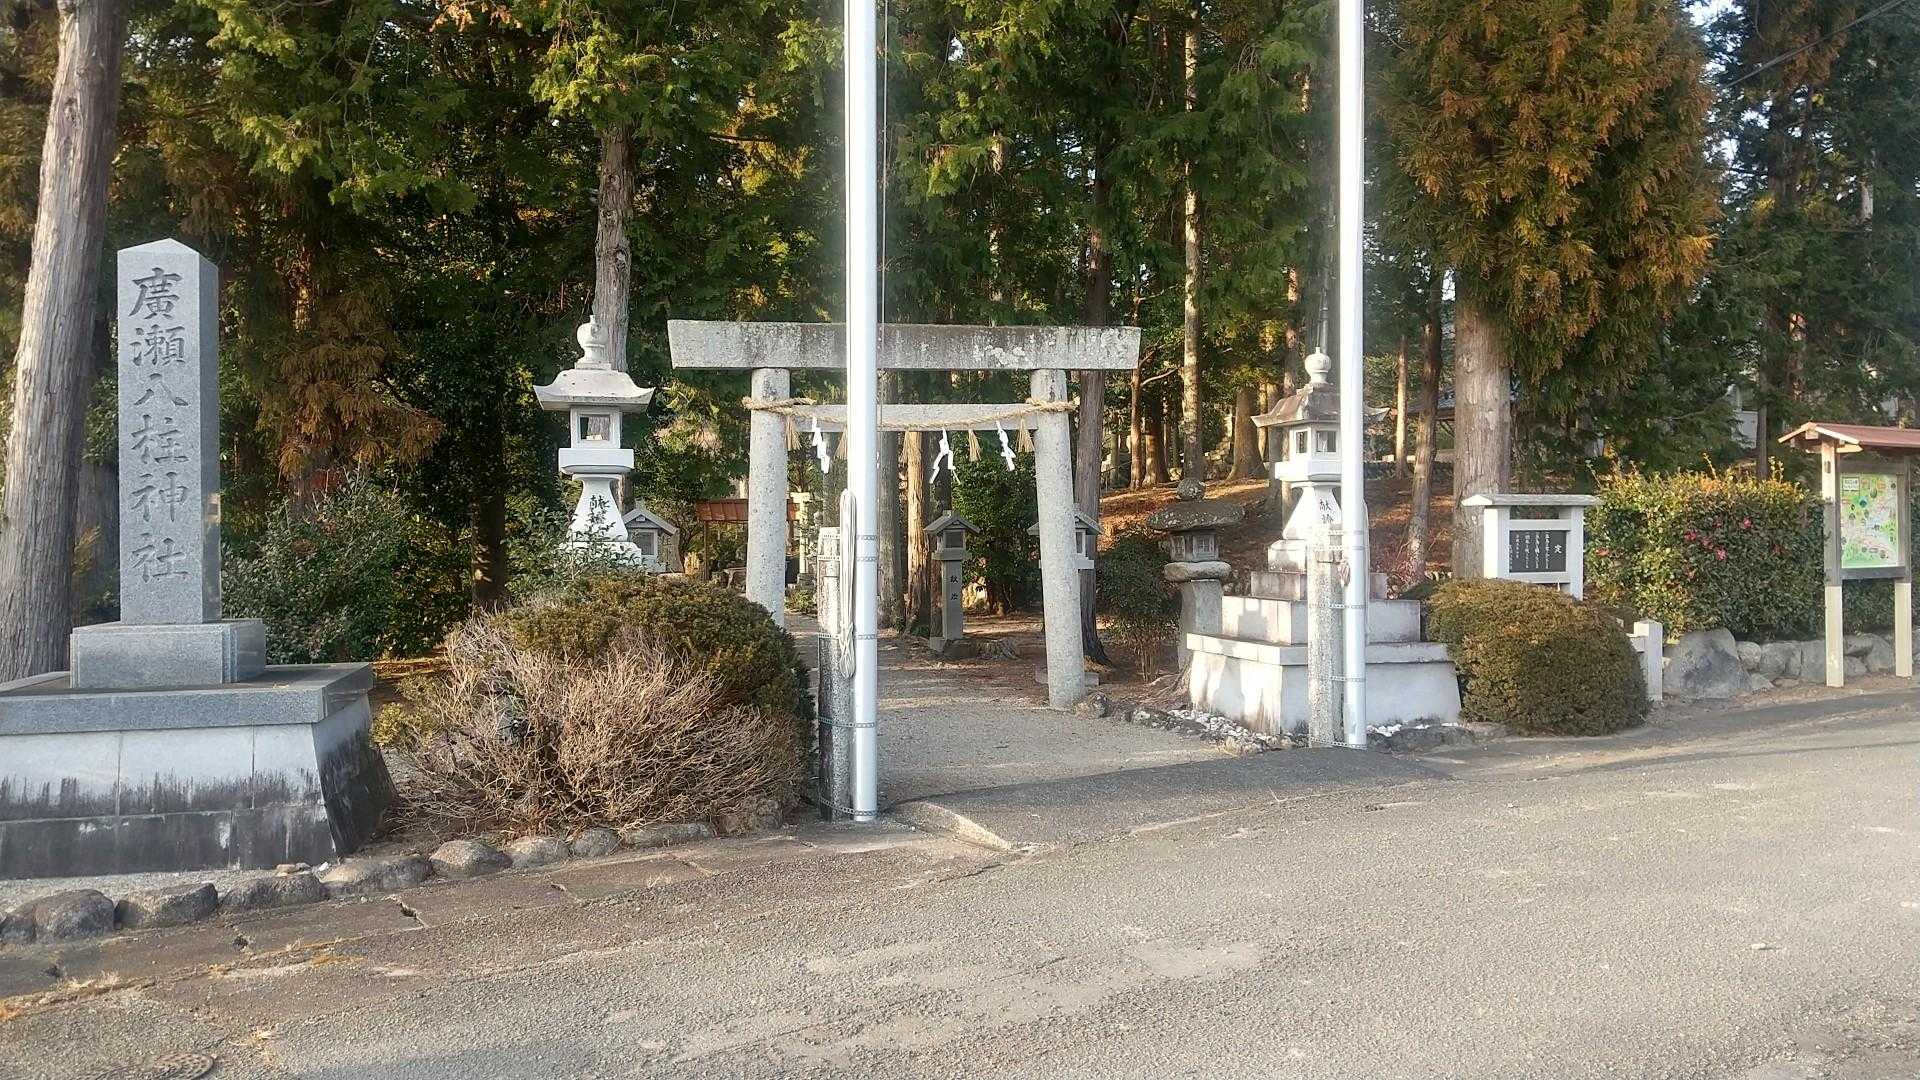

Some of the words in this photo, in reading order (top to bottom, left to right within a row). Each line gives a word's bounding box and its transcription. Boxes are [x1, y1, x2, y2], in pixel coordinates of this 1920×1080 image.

[128, 267, 189, 583] 廣瀬八柱神社
